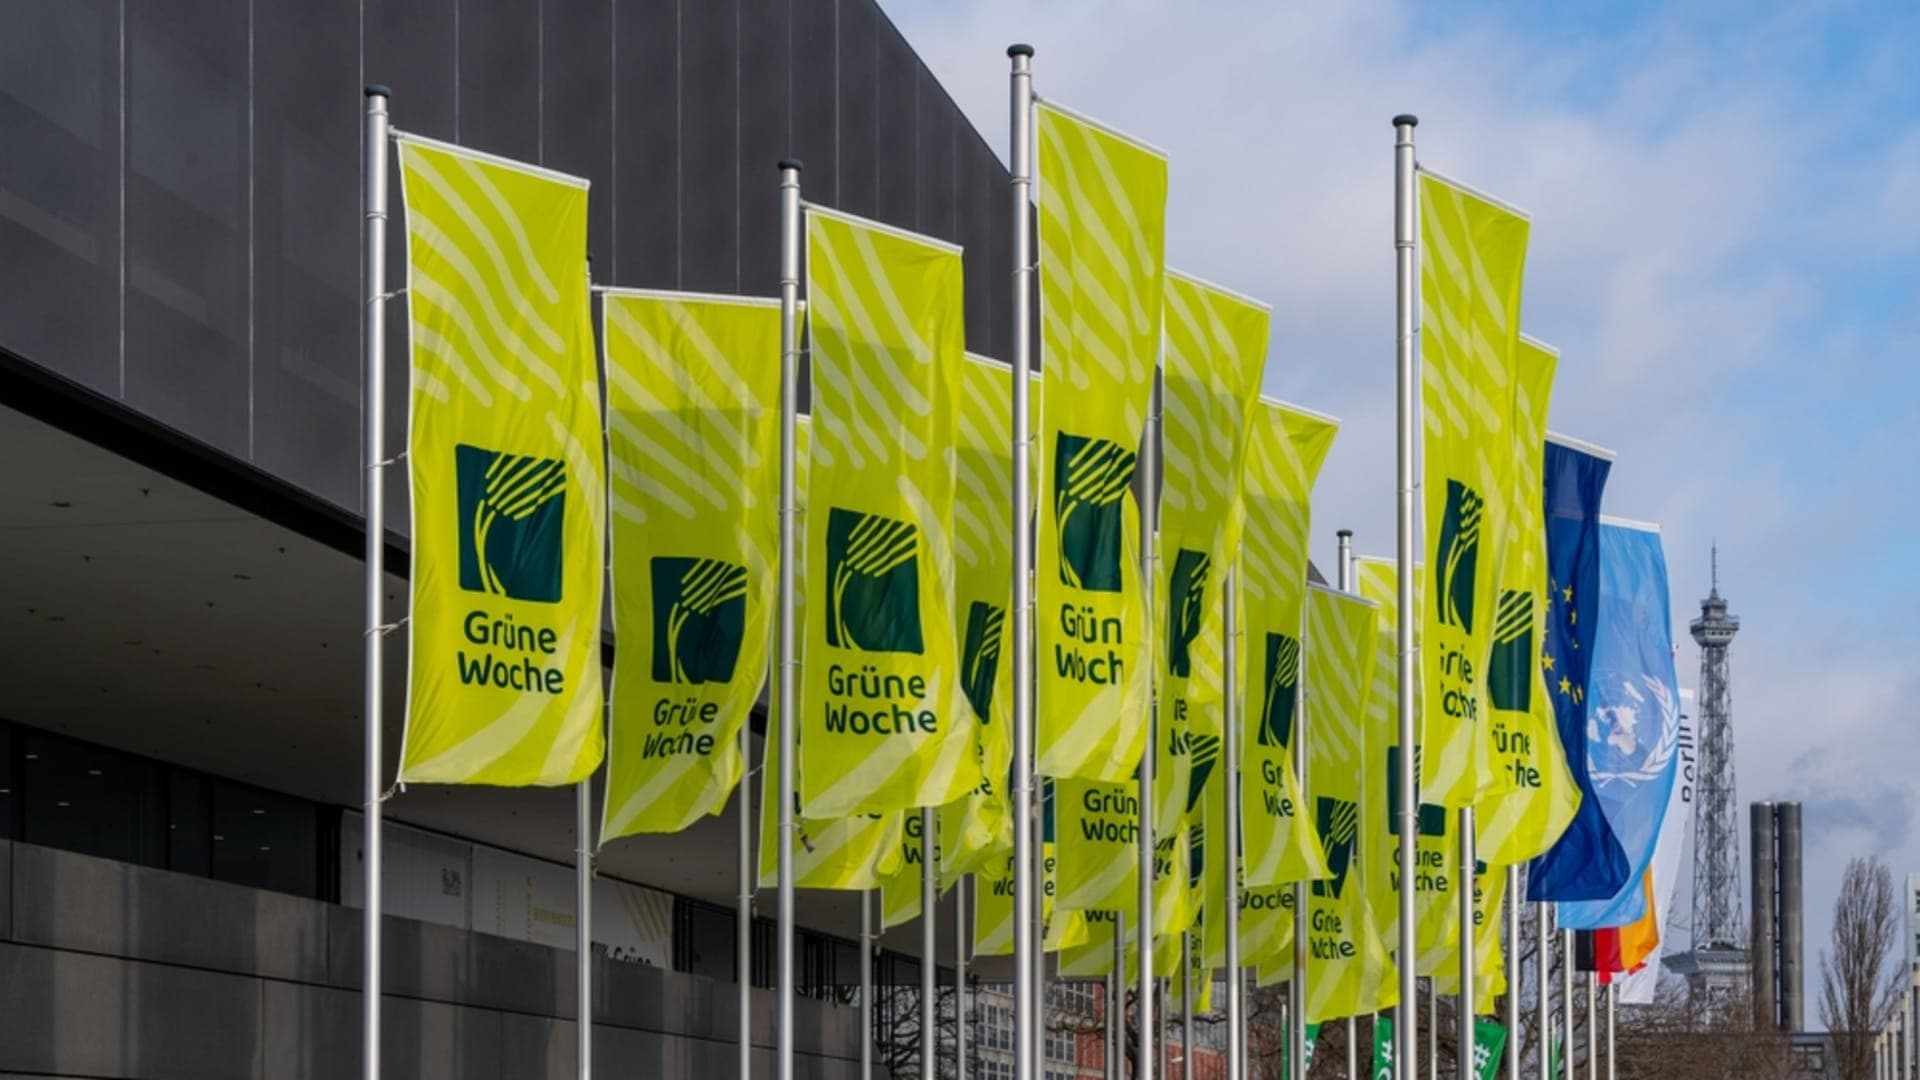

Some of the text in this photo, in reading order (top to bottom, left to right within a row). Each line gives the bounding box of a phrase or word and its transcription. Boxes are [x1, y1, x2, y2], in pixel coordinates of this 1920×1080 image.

[464, 610, 557, 654] Grüne
[457, 651, 564, 695] Woche
[828, 664, 926, 699] Grüne
[1055, 643, 1124, 685] Woch
[825, 701, 938, 735] Woche
[1083, 788, 1138, 815] Grün
[1081, 818, 1138, 844] Woch
